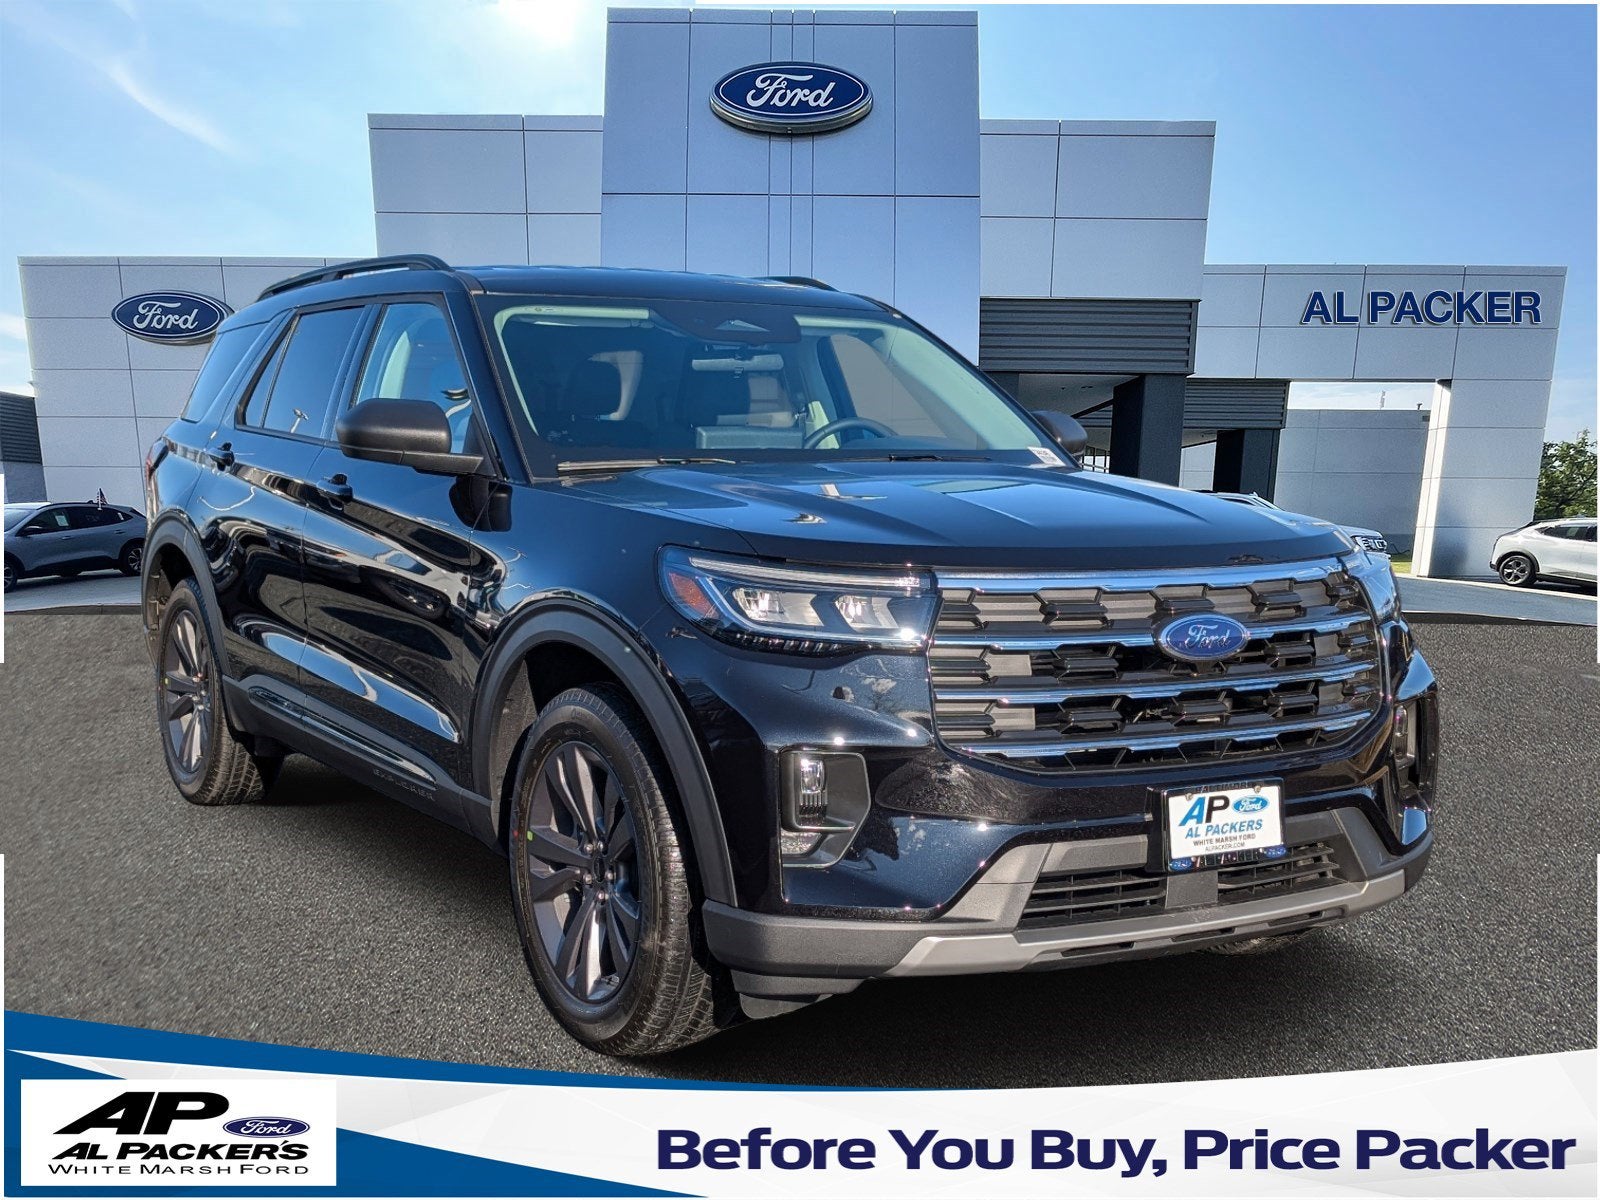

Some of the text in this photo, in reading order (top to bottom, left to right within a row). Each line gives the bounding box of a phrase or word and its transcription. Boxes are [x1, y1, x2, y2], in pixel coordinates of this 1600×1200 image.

[746, 73, 836, 108] Ford
[133, 301, 199, 329] Ford
[1302, 289, 1543, 325] AL PACKER
[1184, 624, 1231, 648] Ford
[1179, 795, 1230, 827] AP
[1239, 799, 1262, 812] Ford
[1185, 819, 1263, 839] AL PACKERS
[1193, 838, 1214, 847] WHITE
[1215, 835, 1238, 845] MARSH
